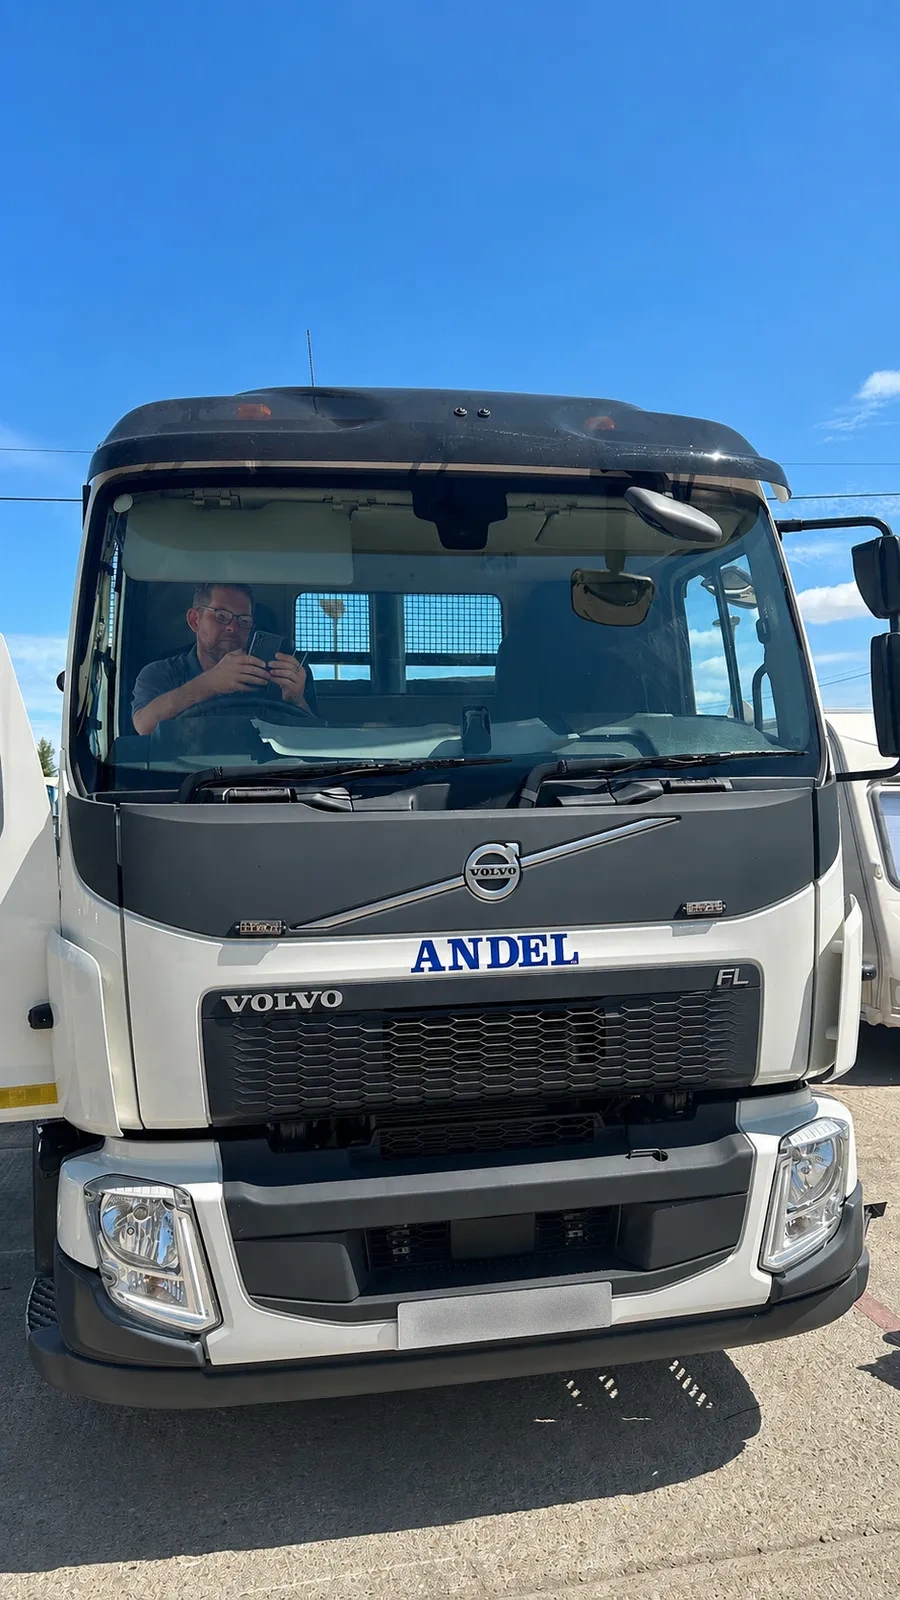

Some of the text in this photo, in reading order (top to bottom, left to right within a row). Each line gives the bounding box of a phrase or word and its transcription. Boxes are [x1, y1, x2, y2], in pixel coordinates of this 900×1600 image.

[469, 867, 517, 877] VOLVO
[411, 933, 579, 973] ANDEL
[716, 968, 749, 985] FL
[221, 989, 343, 1013] VOLVO
